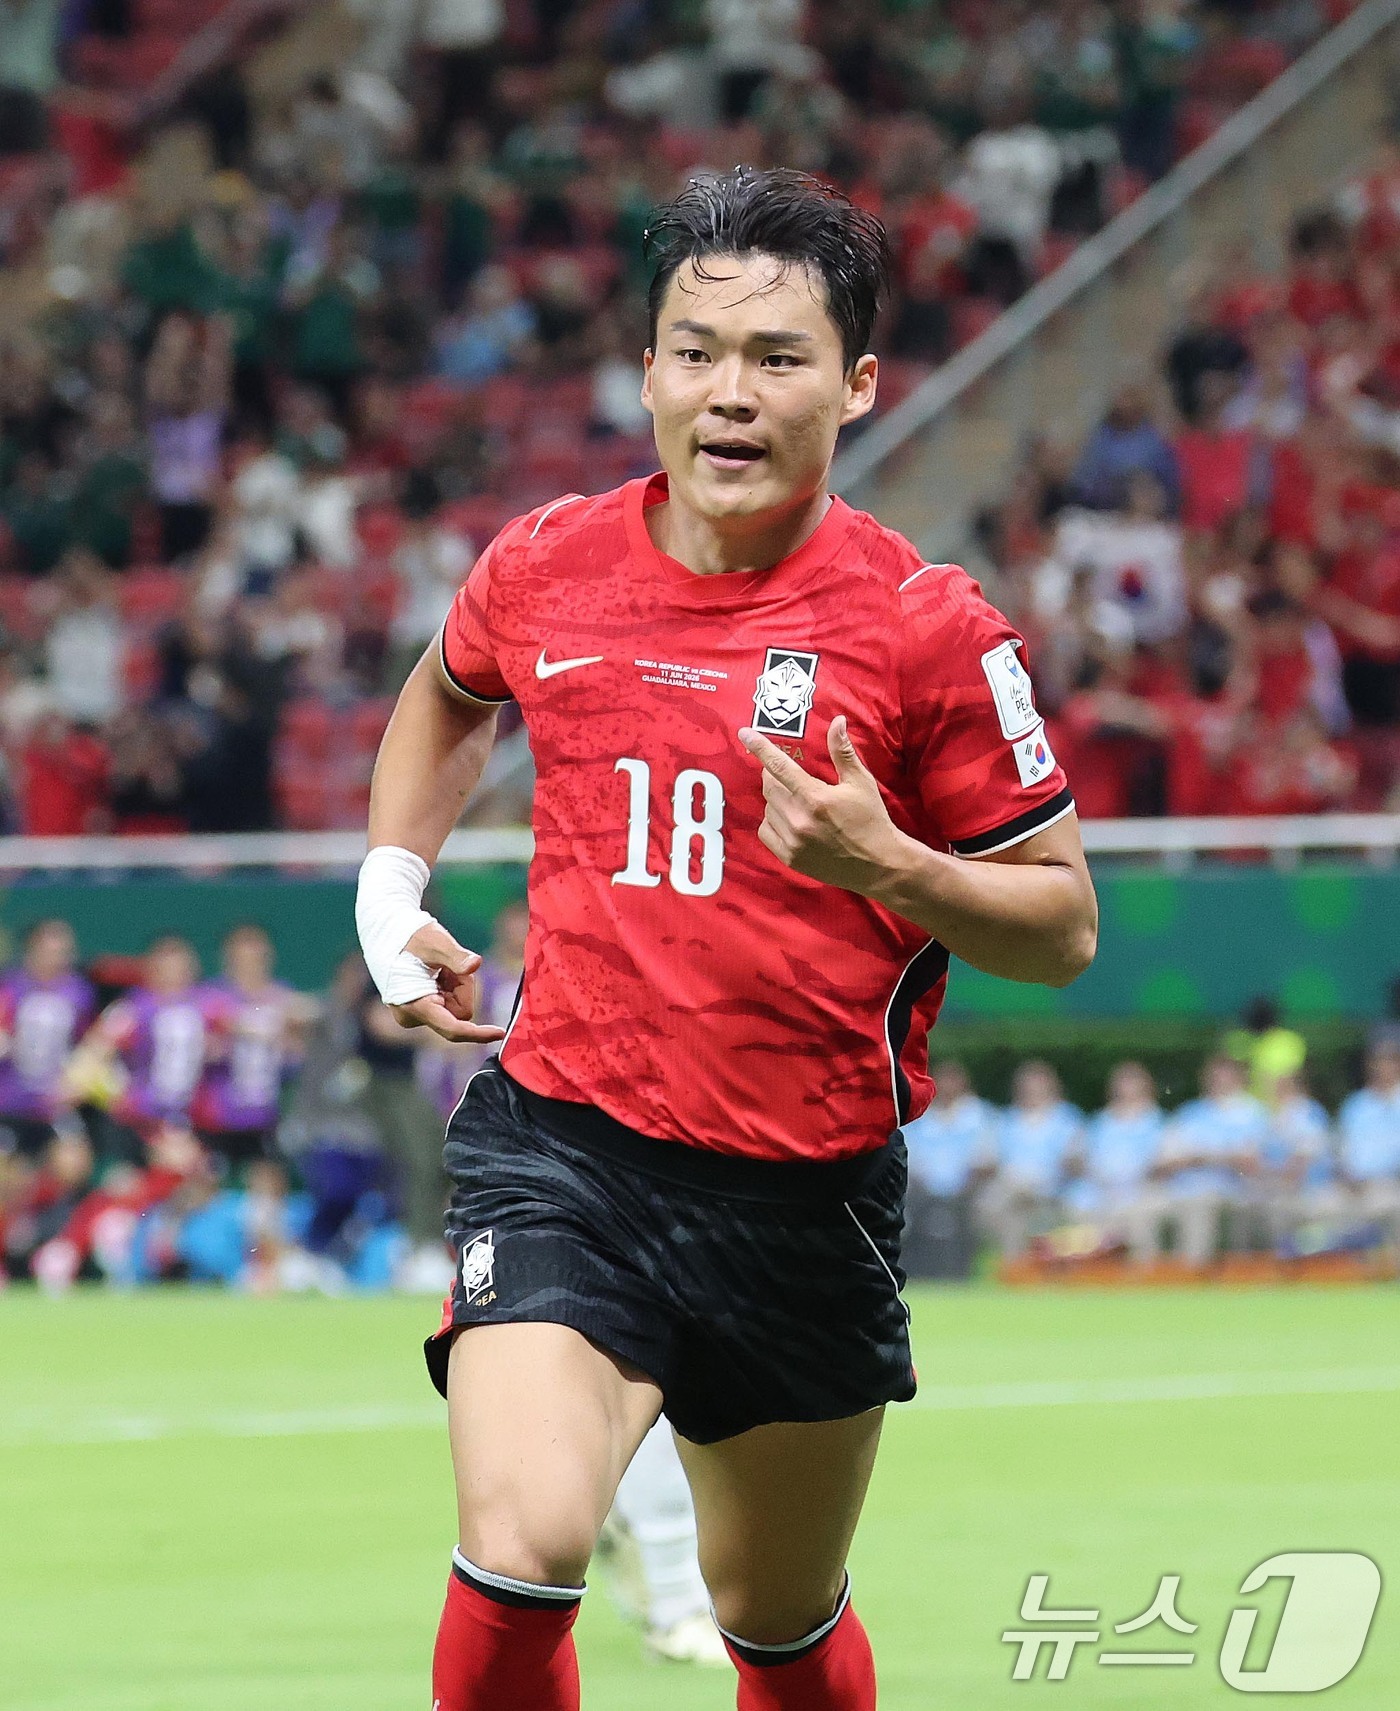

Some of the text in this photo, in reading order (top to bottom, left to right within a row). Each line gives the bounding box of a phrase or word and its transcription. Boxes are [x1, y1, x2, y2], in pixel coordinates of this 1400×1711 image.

[634, 659, 657, 669] KOREA
[658, 663, 690, 673] REPUBLIC
[699, 669, 728, 679] CZECHIA
[669, 671, 683, 679] JUN
[684, 673, 700, 682] 2026
[642, 675, 717, 692] GUADALAJARA, MEXICO
[611, 757, 726, 896] 18
